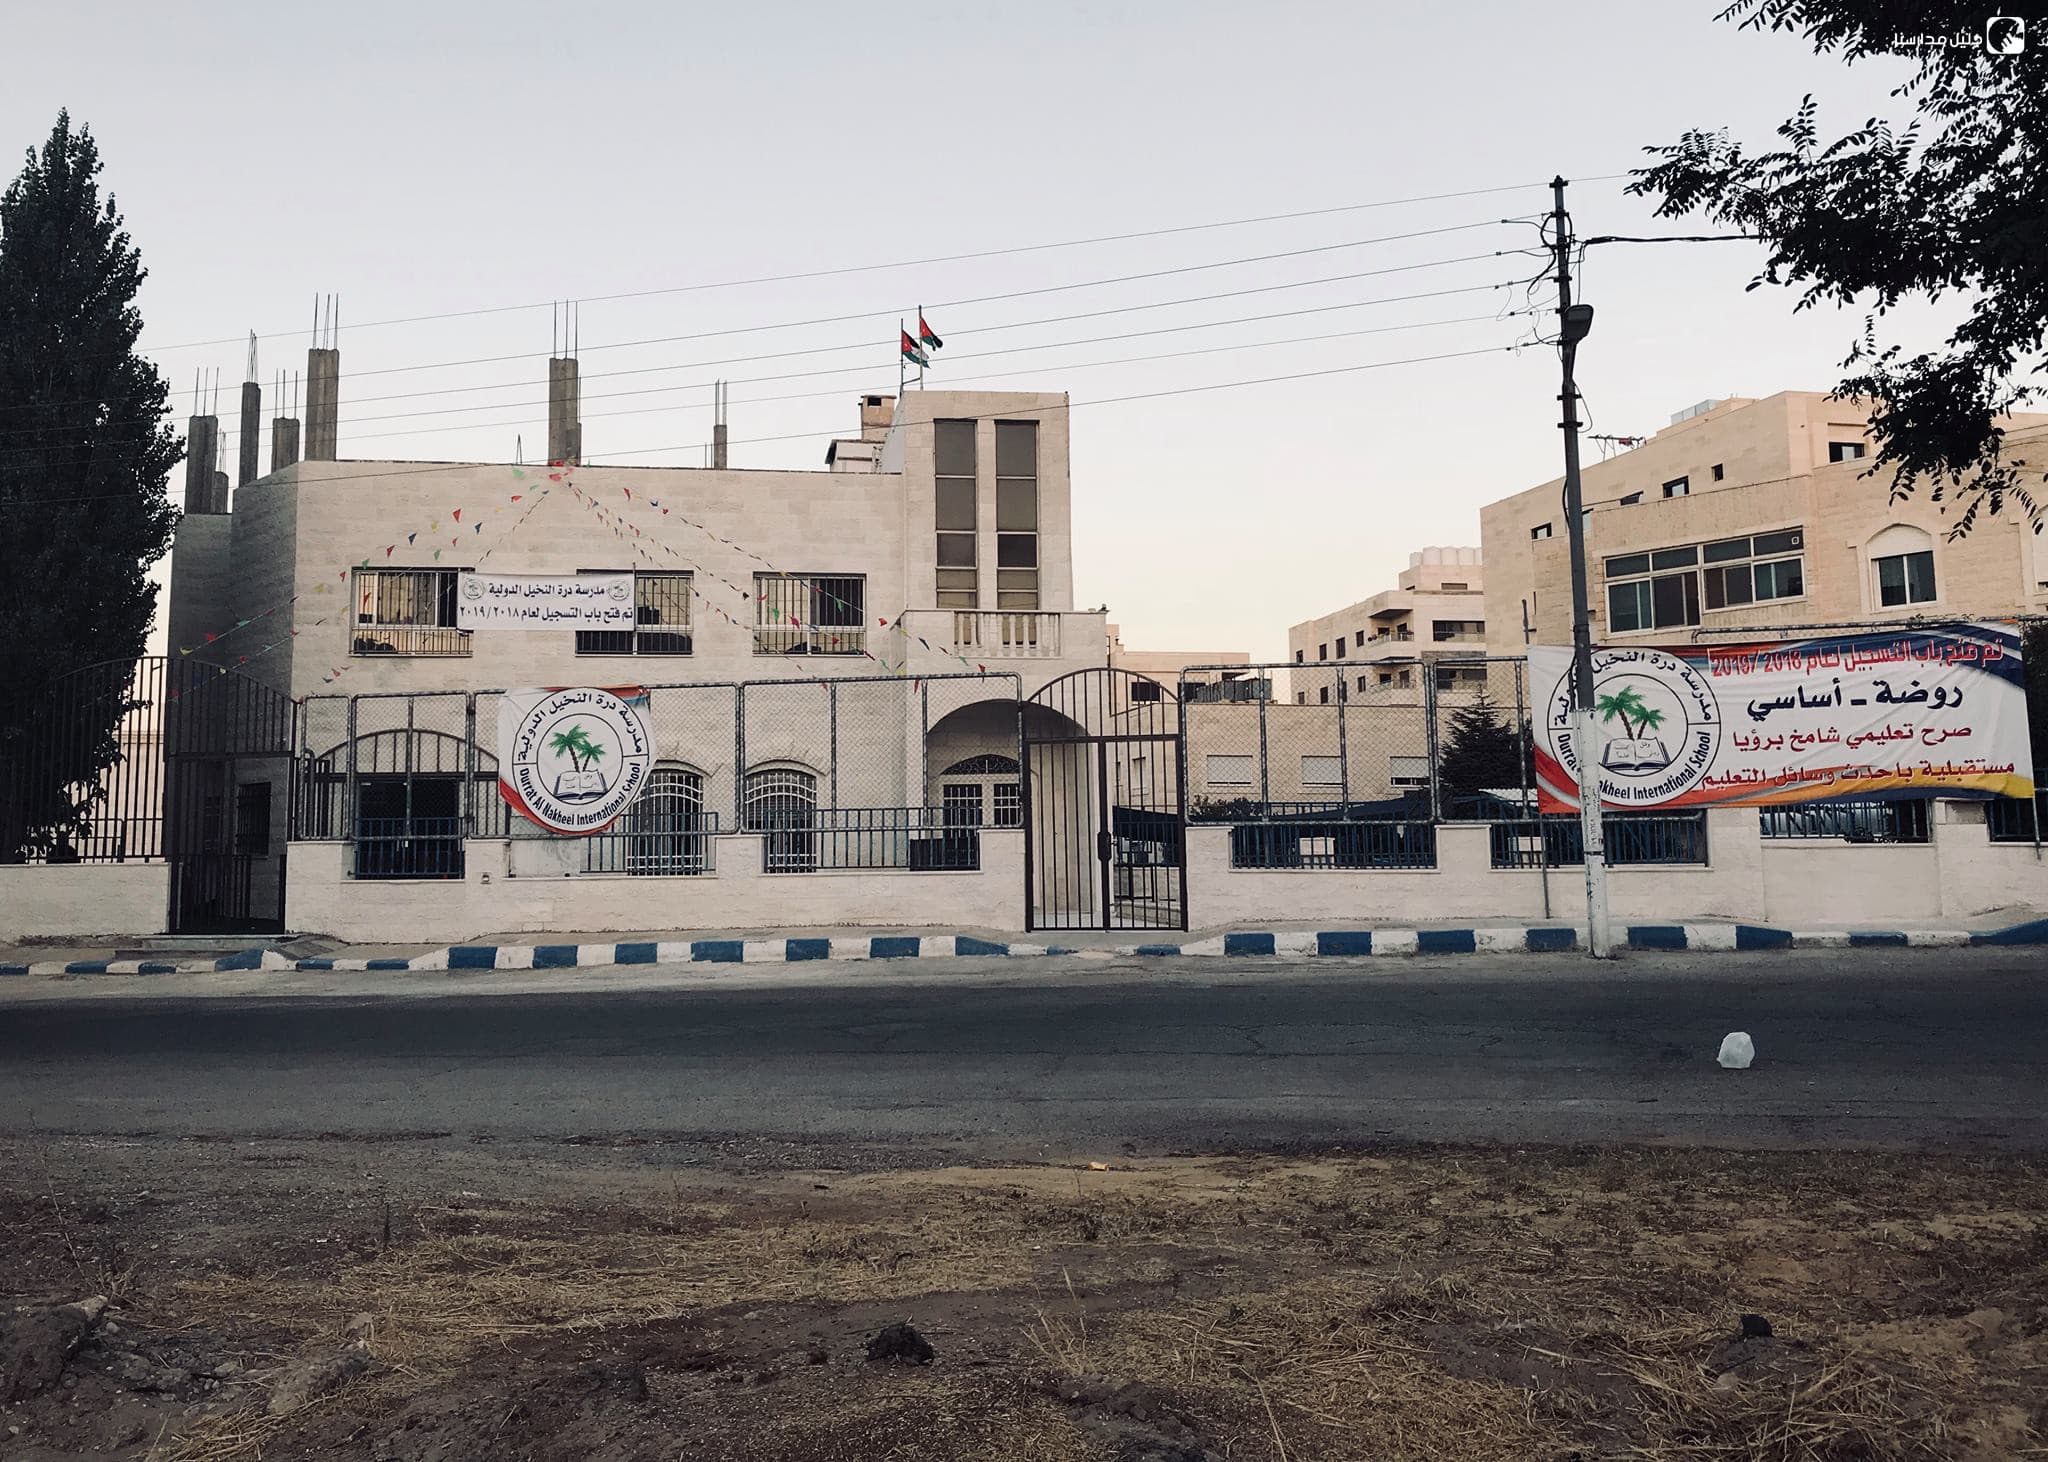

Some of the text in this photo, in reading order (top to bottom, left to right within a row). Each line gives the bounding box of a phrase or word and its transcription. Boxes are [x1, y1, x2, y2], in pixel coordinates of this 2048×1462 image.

[489, 583, 521, 598] الدولية
[524, 585, 554, 597] النخيل
[557, 585, 572, 597] درة
[576, 583, 605, 599] مدرسة
[522, 608, 540, 620] لعام
[542, 607, 581, 622] التسجيل
[584, 609, 601, 623] باب
[604, 608, 620, 623] فتح
[622, 607, 632, 622] تم
[1806, 645, 1840, 675] لعام
[1846, 642, 1910, 673] التسجيل
[1915, 640, 1943, 668] باب
[1946, 637, 1978, 666] فتح
[1981, 638, 2004, 668] تم
[1592, 651, 1712, 721] مدرسة درة النخيل
[1875, 679, 1963, 710] روضة
[1747, 677, 1842, 721] أساسي
[518, 692, 642, 761] مدرسة درة النخيل الدولية
[1734, 723, 1972, 752] صرح تعليمي شامخ برؤيا
[1599, 780, 1630, 800] akheel
[1634, 766, 1697, 800] International
[1689, 731, 1711, 769] School
[1773, 766, 1835, 788] وسائل
[1919, 759, 2015, 782] مستقبلية
[1701, 768, 1766, 791] التعليم
[519, 762, 641, 826] Durrat Al Nakheel International School
